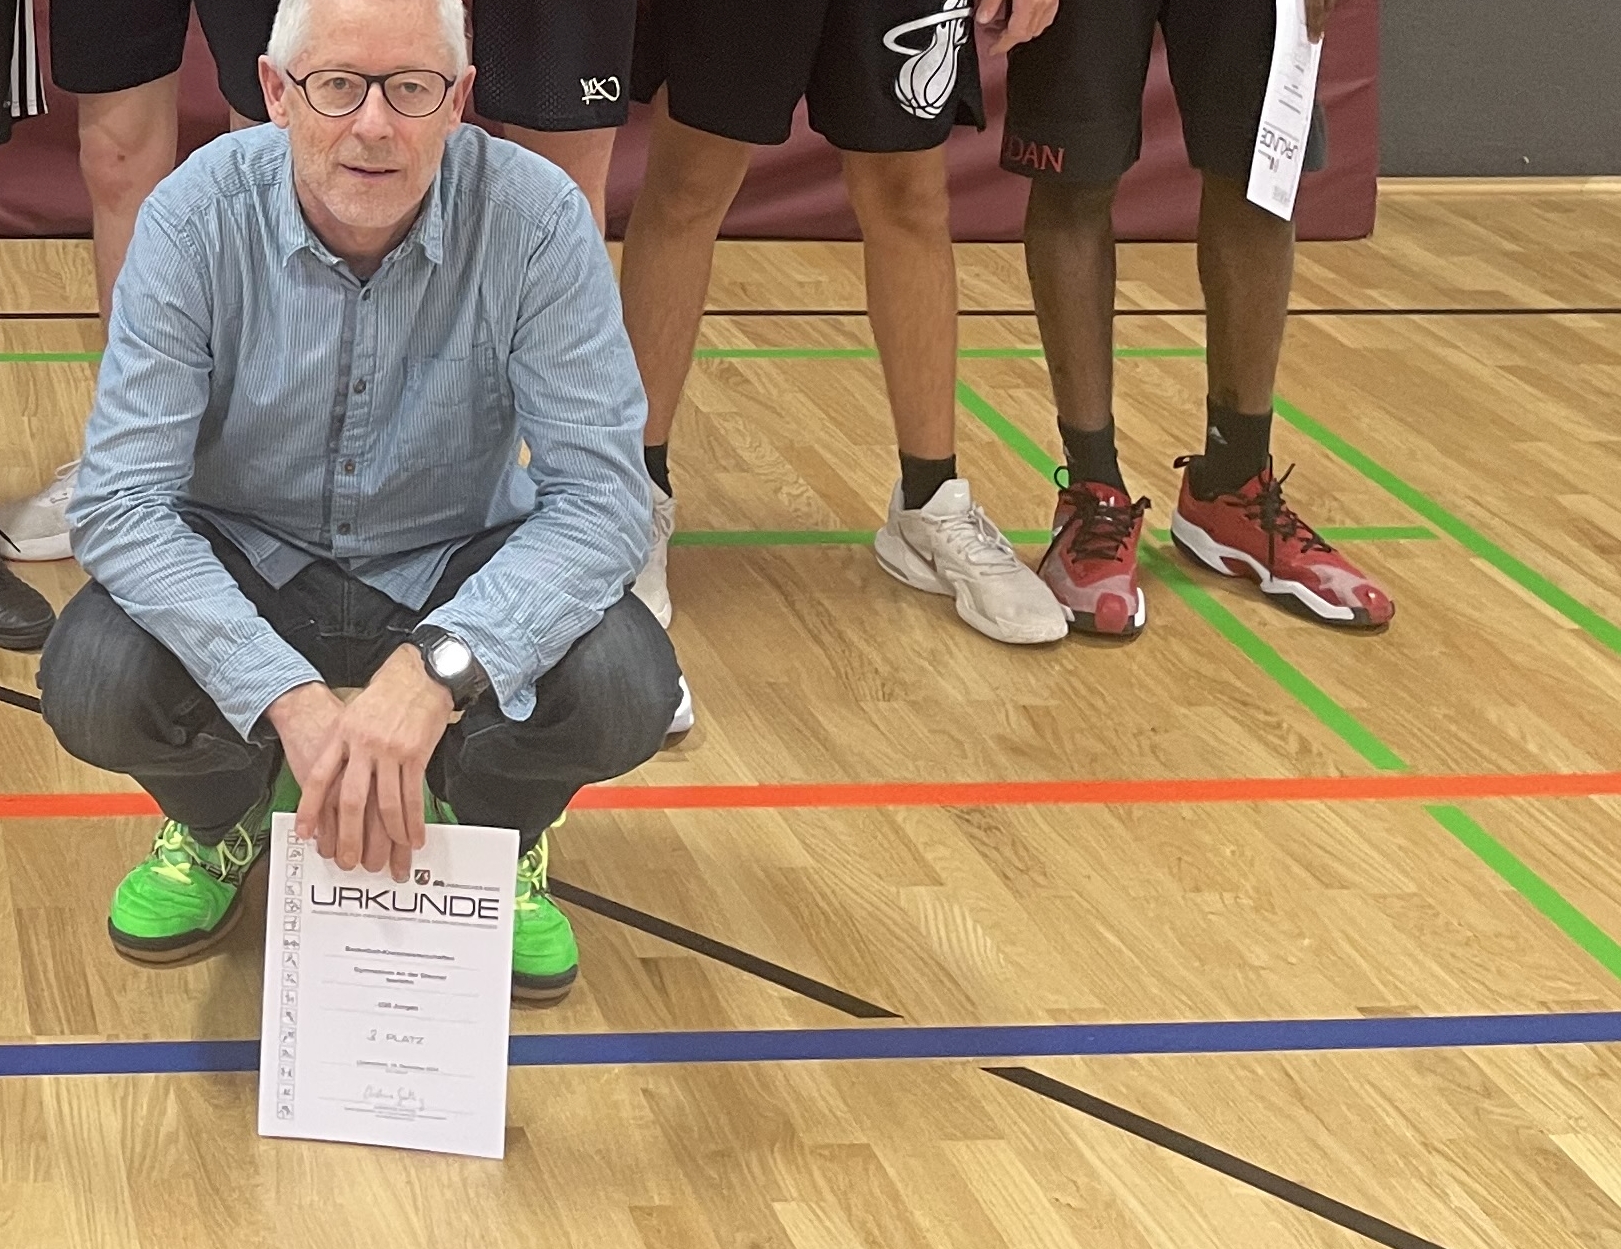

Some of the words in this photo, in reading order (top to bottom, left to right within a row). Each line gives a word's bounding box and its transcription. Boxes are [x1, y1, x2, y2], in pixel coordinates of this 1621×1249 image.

[1005, 135, 1066, 173] DAN
[311, 885, 500, 920] URKUNDE
[385, 1033, 425, 1045] PLATZ
